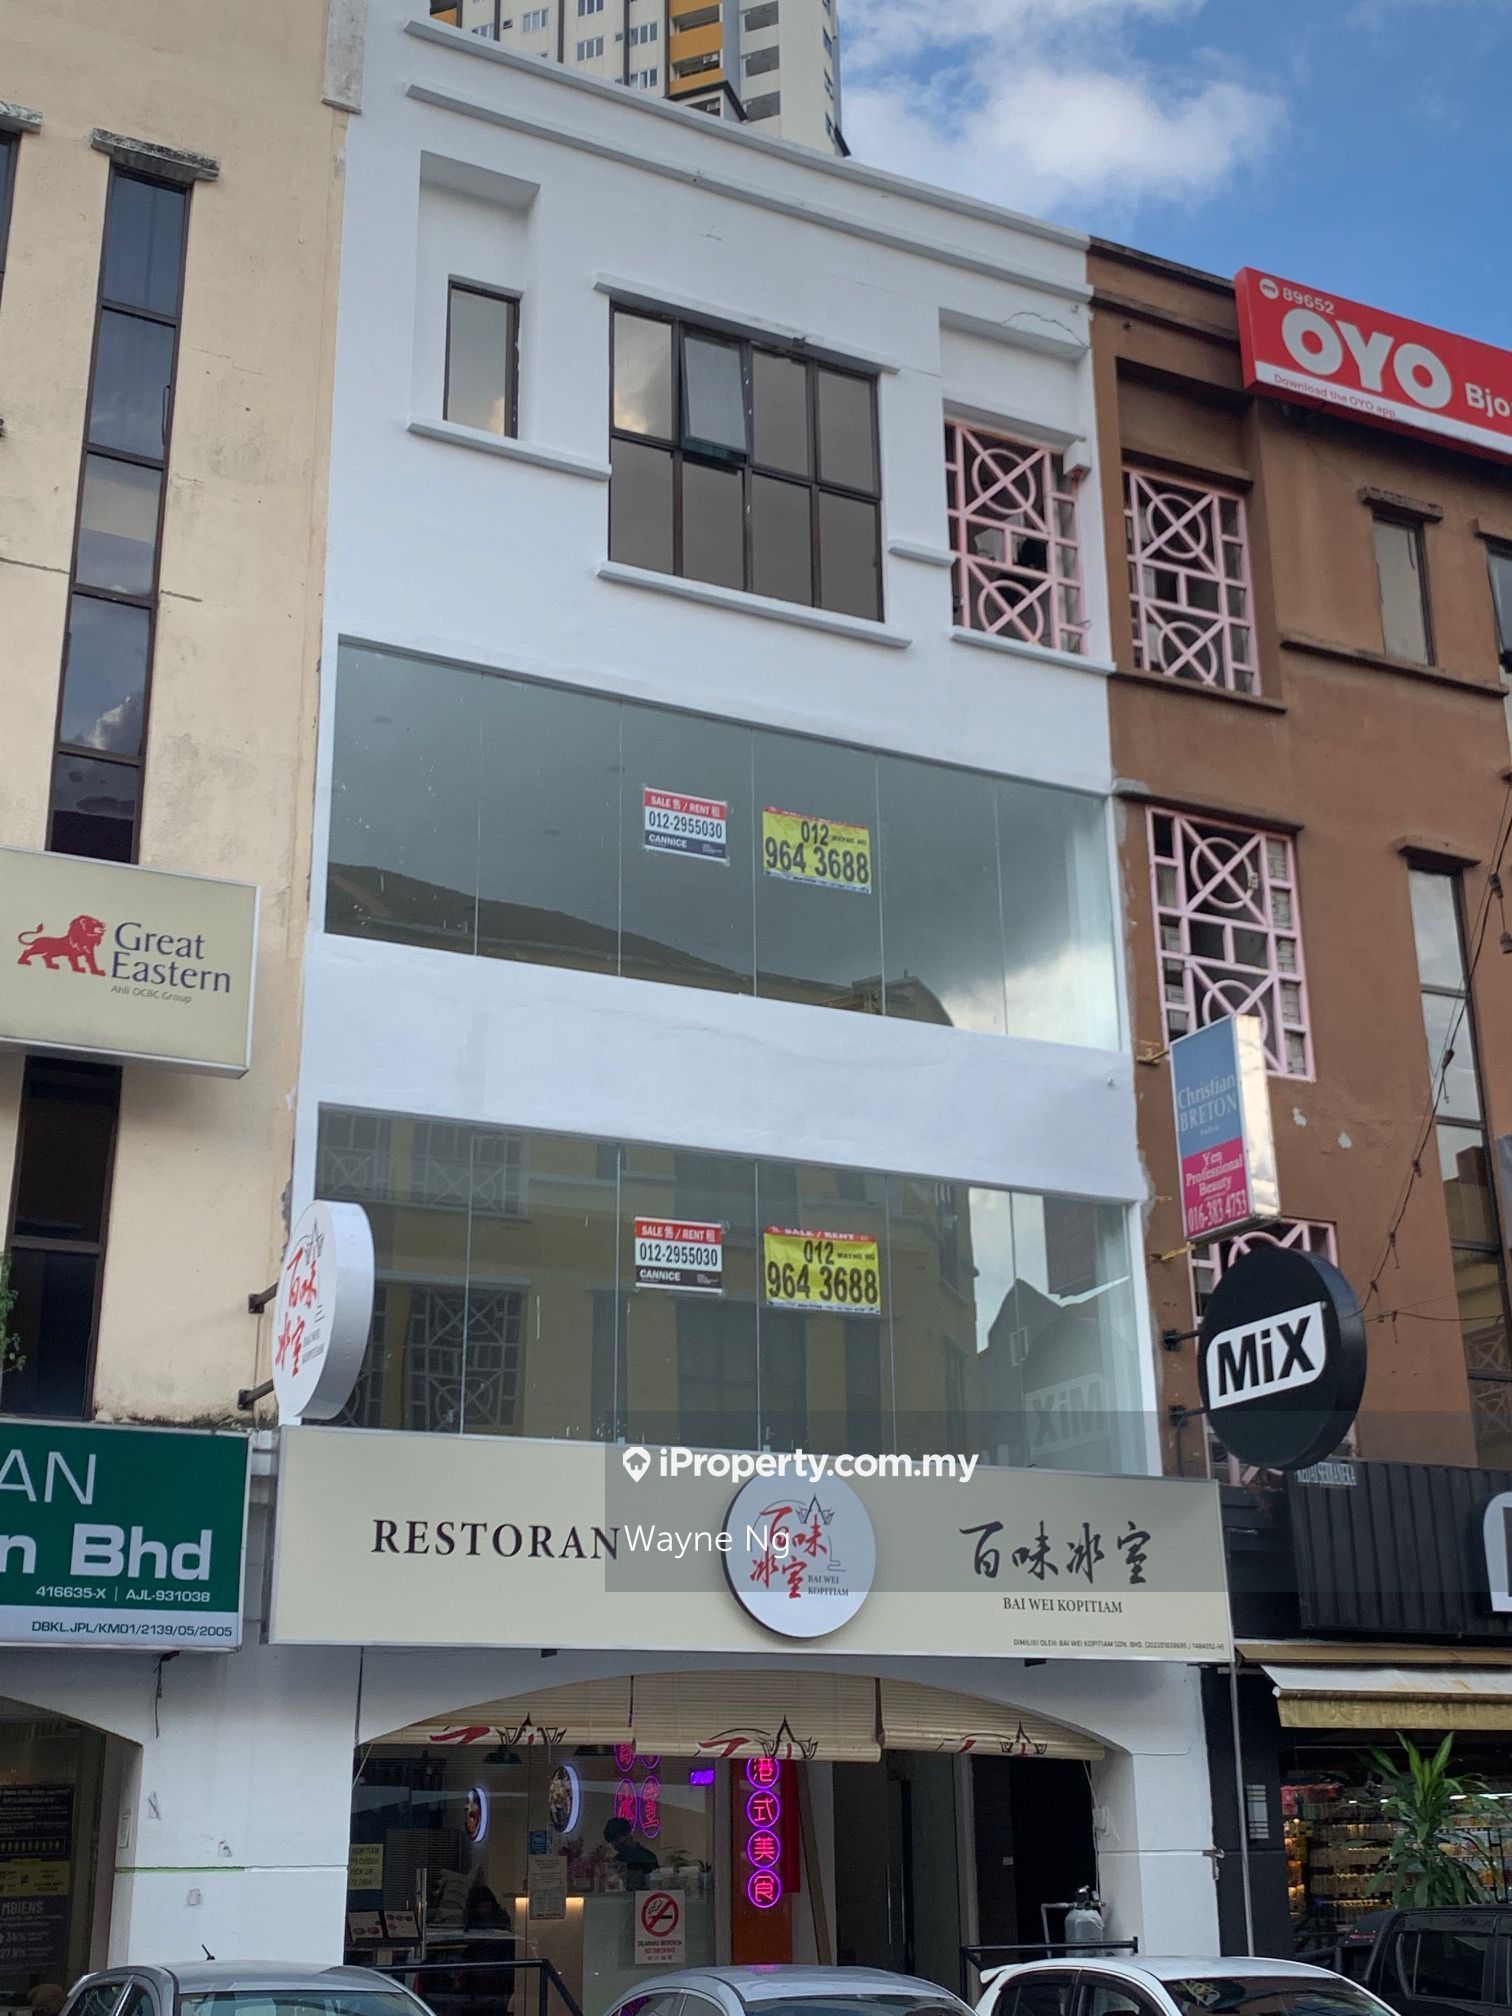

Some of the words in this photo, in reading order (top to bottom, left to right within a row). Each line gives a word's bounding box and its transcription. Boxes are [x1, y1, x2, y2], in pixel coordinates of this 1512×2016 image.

[1282, 287, 1335, 316] 89652
[1281, 308, 1452, 409] OYO
[1273, 374, 1328, 398] Download
[1330, 390, 1348, 404] the
[1349, 395, 1374, 411] OYO
[1376, 405, 1395, 419] app
[651, 796, 671, 808] SALE
[682, 803, 688, 812] /
[689, 803, 710, 815] RENT
[649, 810, 722, 839] 012-2955030
[801, 821, 829, 846] 012
[648, 833, 688, 848] CANNICE
[765, 836, 806, 873] 964
[813, 846, 868, 884] 3688
[115, 922, 205, 960] Great
[111, 951, 230, 993] Eastern
[132, 988, 159, 999] OCBC
[162, 991, 192, 1004] Group
[1177, 1074, 1235, 1109] Christian
[1180, 1091, 1237, 1132] BRETON
[1186, 1153, 1243, 1187] Professional
[1199, 1175, 1232, 1196] Beauty
[641, 1225, 662, 1237] SALE
[674, 1228, 681, 1240] /
[682, 1228, 705, 1241] RENT
[639, 1242, 718, 1266] 012-2955030
[804, 1240, 834, 1265] 012
[639, 1269, 681, 1282] CANNICE
[767, 1261, 810, 1299] 964
[819, 1266, 878, 1304] 3688
[1217, 1315, 1316, 1397] MiX
[0, 1449, 97, 1505] AN
[70, 1523, 213, 1581] Bhd
[371, 1519, 621, 1560] RESTORAN
[959, 1520, 1151, 1585] 百味冰室
[35, 1585, 106, 1600] 416635-X
[125, 1590, 210, 1603] AJL-931038
[808, 1587, 848, 1597] KOPITIAM
[1003, 1597, 1026, 1610] BAI
[1029, 1598, 1054, 1612] WEI
[1057, 1600, 1123, 1614] KOPITIAM
[31, 1621, 232, 1638] DBKL.JPL/KM01/2139/05/2005
[1059, 1639, 1069, 1647] BAI
[1071, 1639, 1082, 1647] WEI
[1084, 1640, 1113, 1648] KOPITIAM
